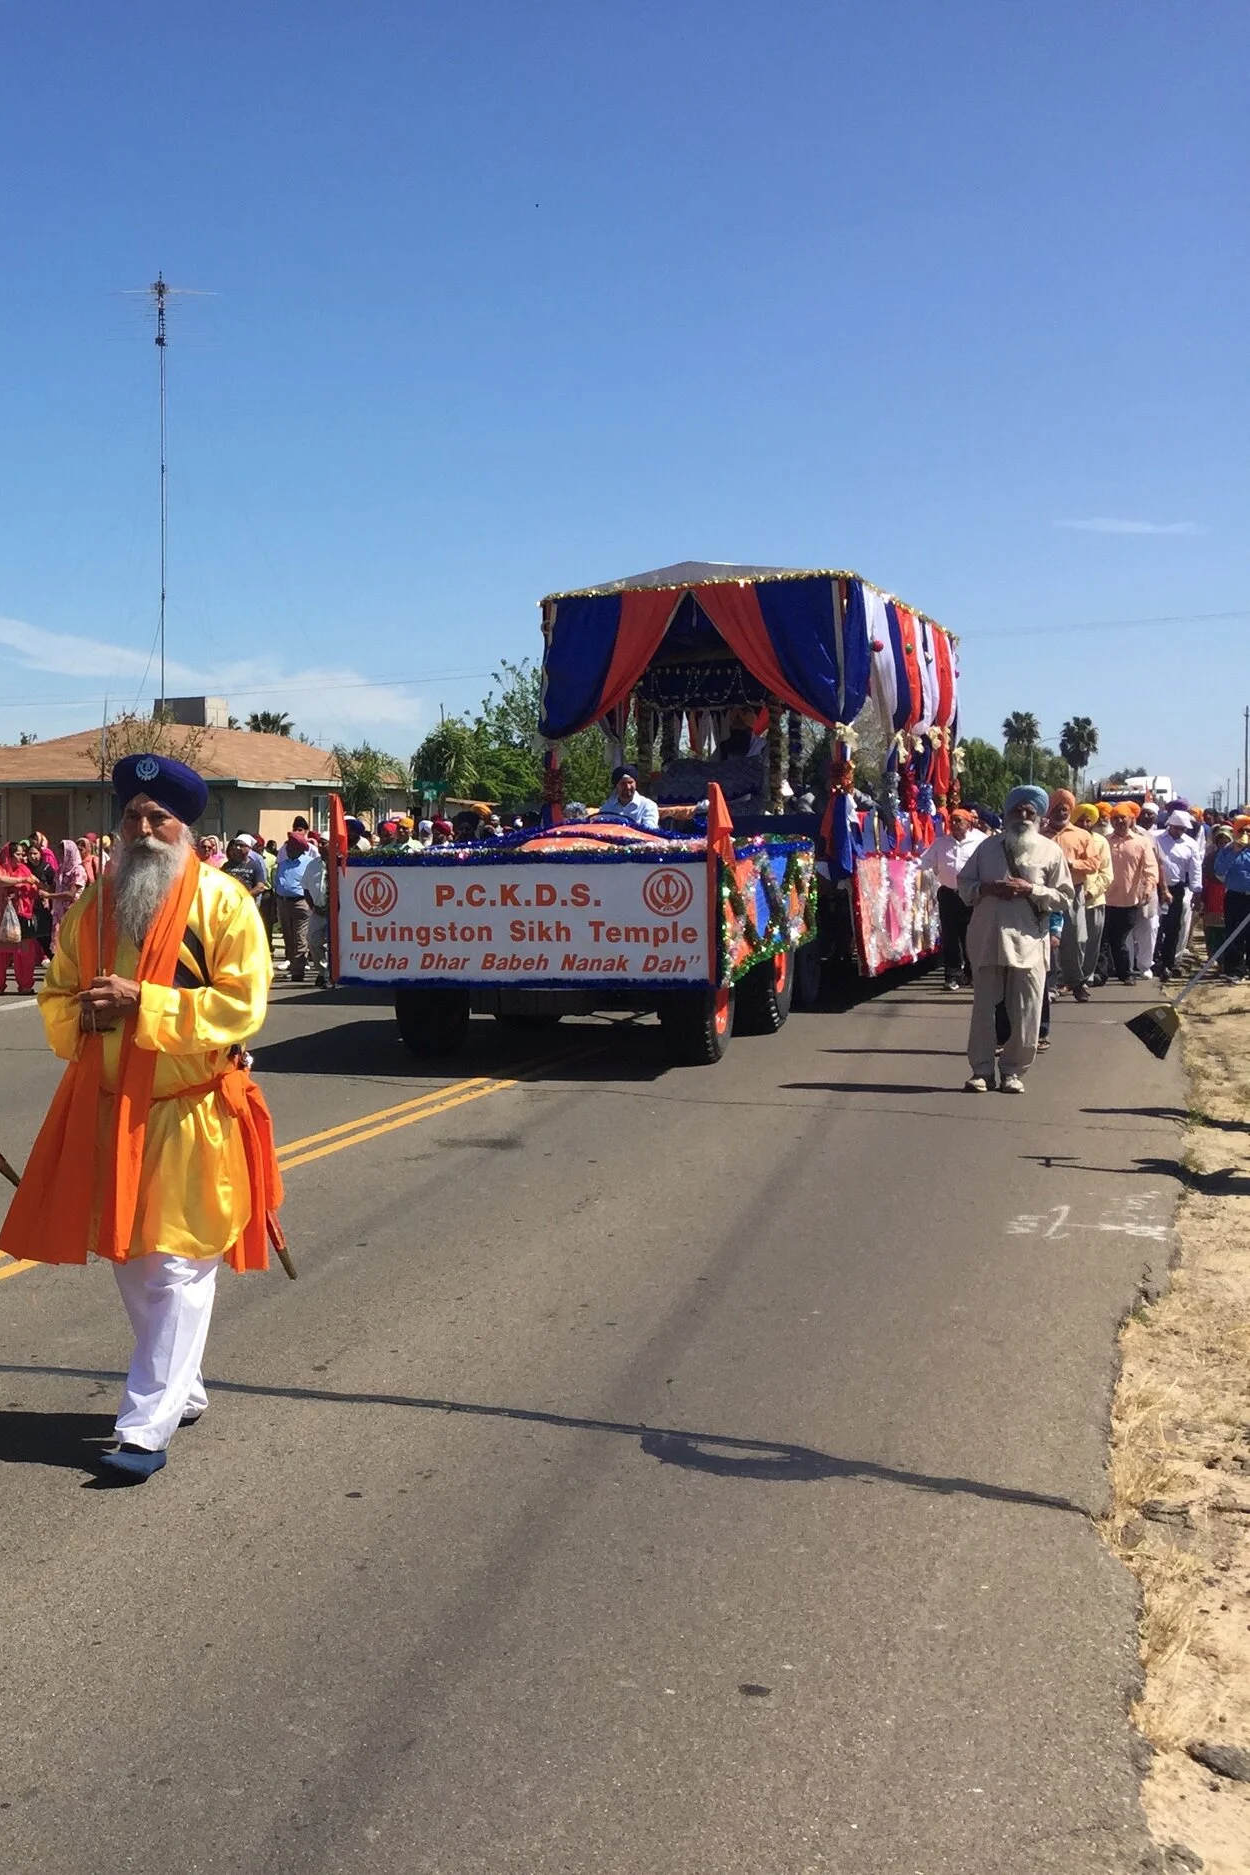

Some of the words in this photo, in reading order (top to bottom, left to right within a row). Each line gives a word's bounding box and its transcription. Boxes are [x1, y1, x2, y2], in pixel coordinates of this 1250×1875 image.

[435, 883, 602, 908] P.C.K.D.S.
[351, 920, 493, 948] Livingston
[509, 919, 571, 943] Sikh
[588, 920, 699, 948] Temple
[420, 952, 471, 971] Dhar
[480, 952, 549, 971] Babeh
[560, 953, 629, 973] Nanak
